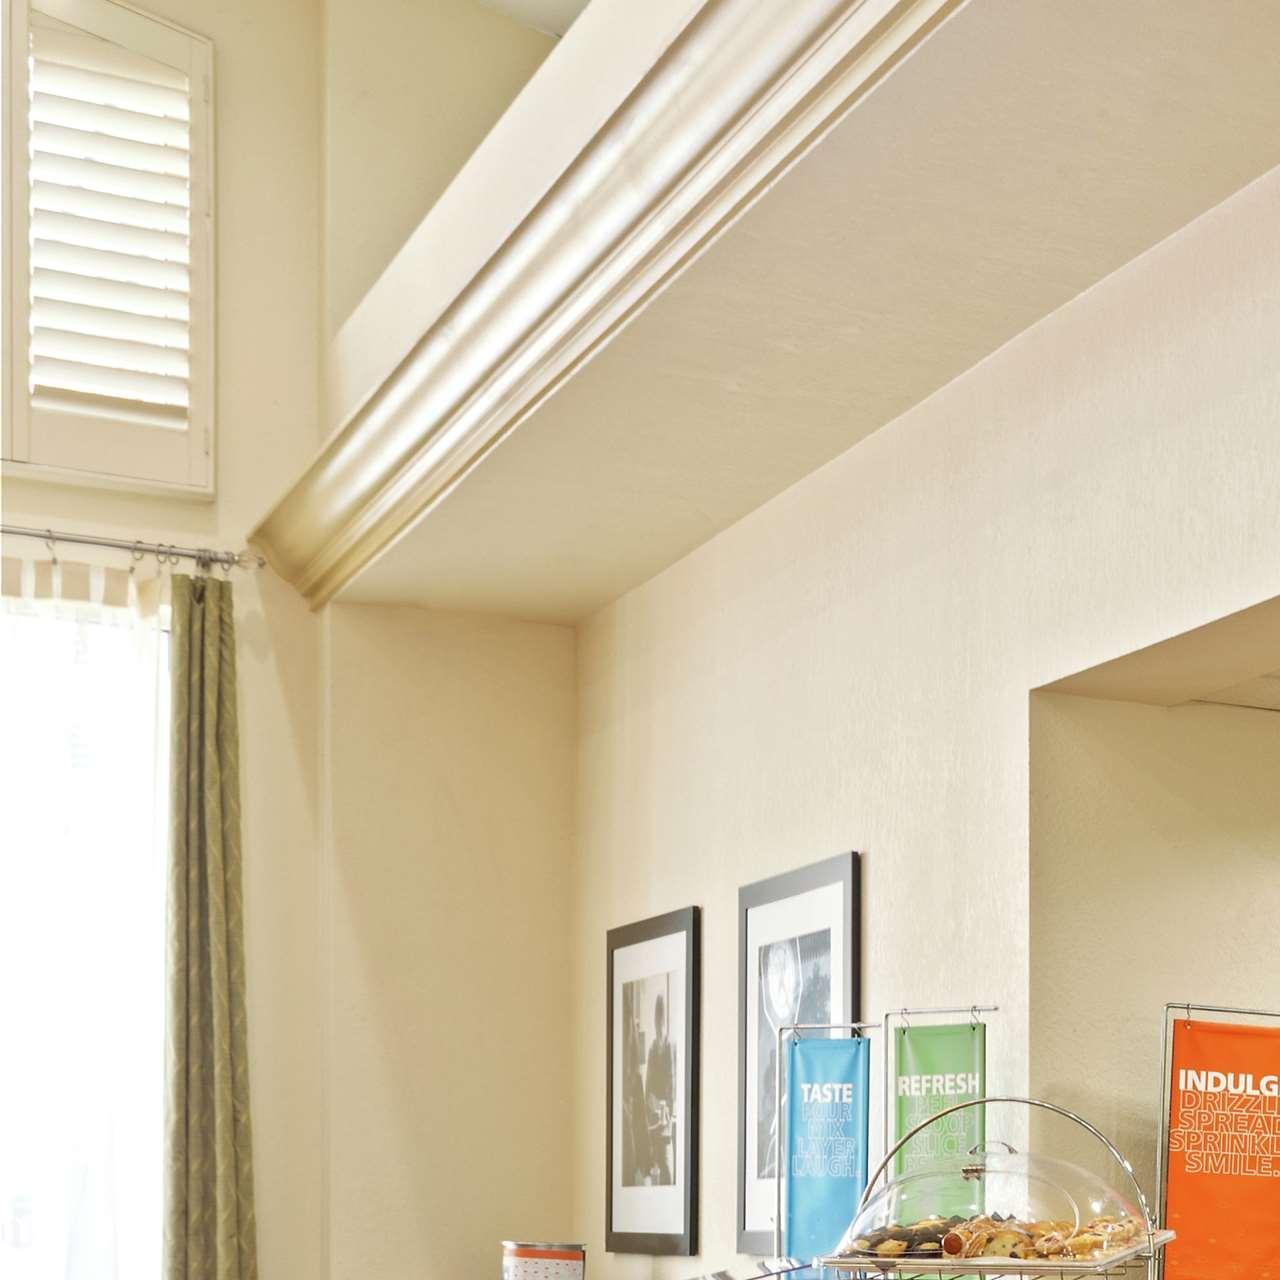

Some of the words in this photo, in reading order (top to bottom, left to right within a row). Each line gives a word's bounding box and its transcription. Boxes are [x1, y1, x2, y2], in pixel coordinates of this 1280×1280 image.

[801, 1083, 853, 1103] TASTE
[898, 1073, 980, 1096] REFRESH
[801, 1102, 852, 1120] POUR
[808, 1119, 845, 1138] MIX
[798, 1137, 856, 1157] LAYER
[792, 1154, 861, 1177] LAUGH.
[1185, 1150, 1280, 1177] SMILE.
